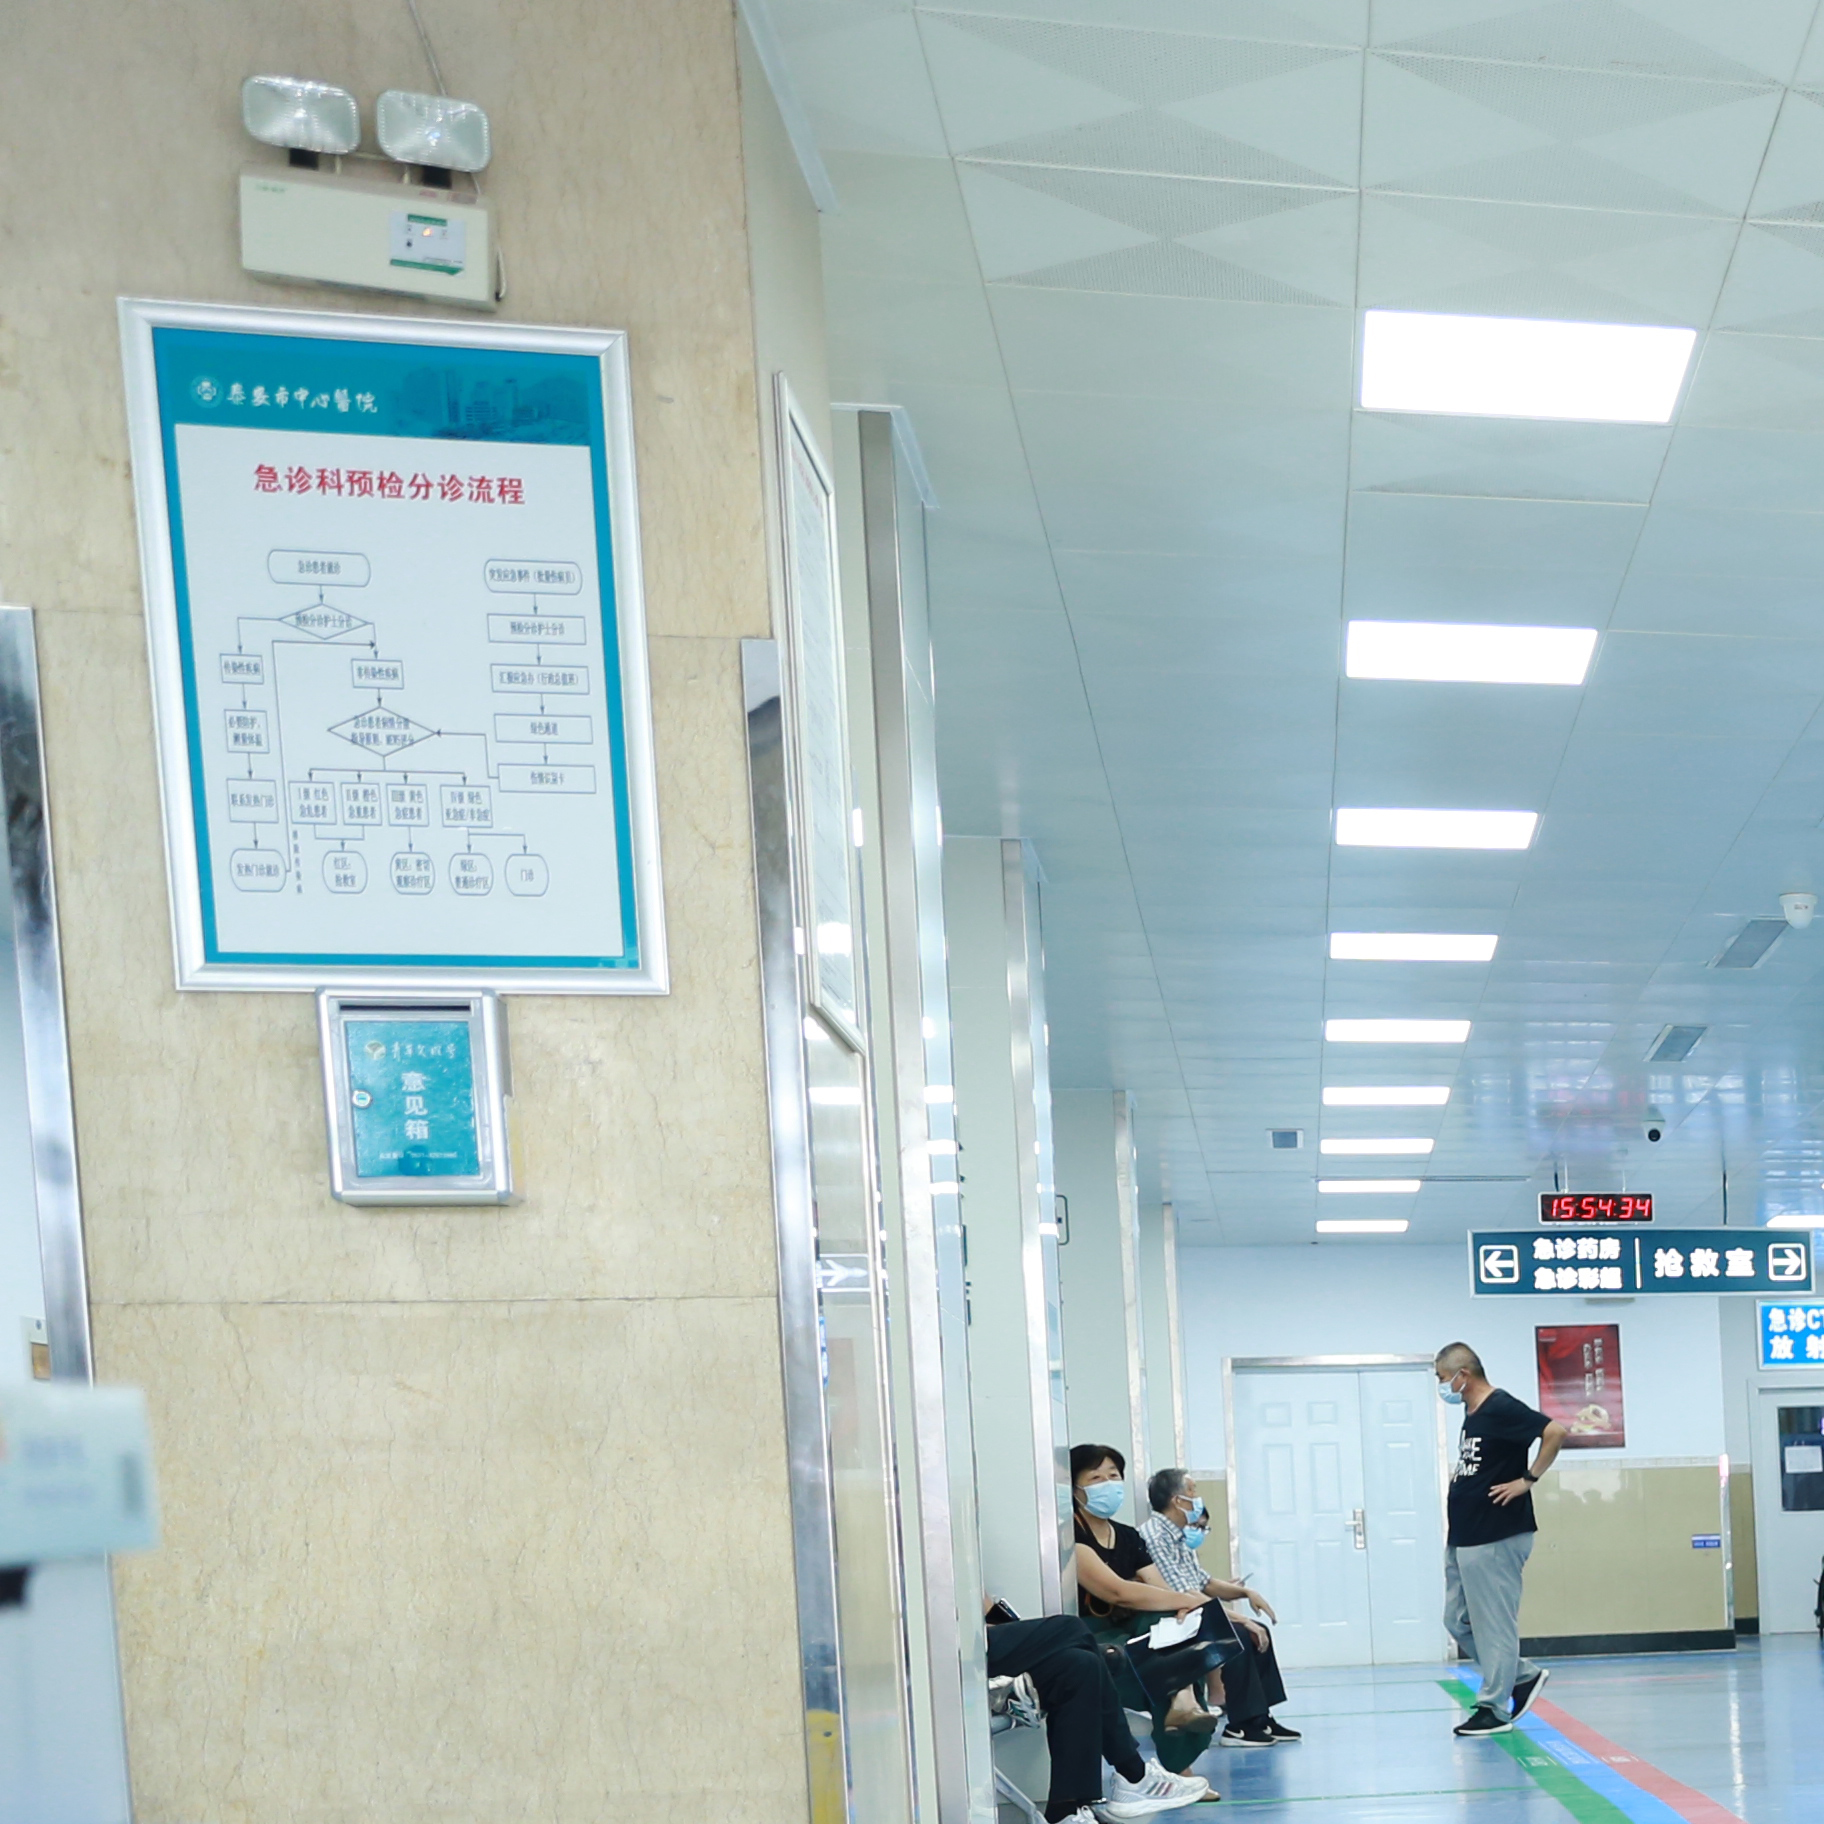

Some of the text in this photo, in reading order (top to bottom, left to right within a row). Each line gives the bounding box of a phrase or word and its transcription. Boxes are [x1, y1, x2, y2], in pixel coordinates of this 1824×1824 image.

[254, 463, 526, 506] 急诊科预检分诊流程
[401, 1071, 430, 1140] 意见箱
[1551, 1197, 1651, 1219] 15:54:34
[1533, 1237, 1621, 1260] 急诊药房
[1653, 1247, 1756, 1278] 抢救室
